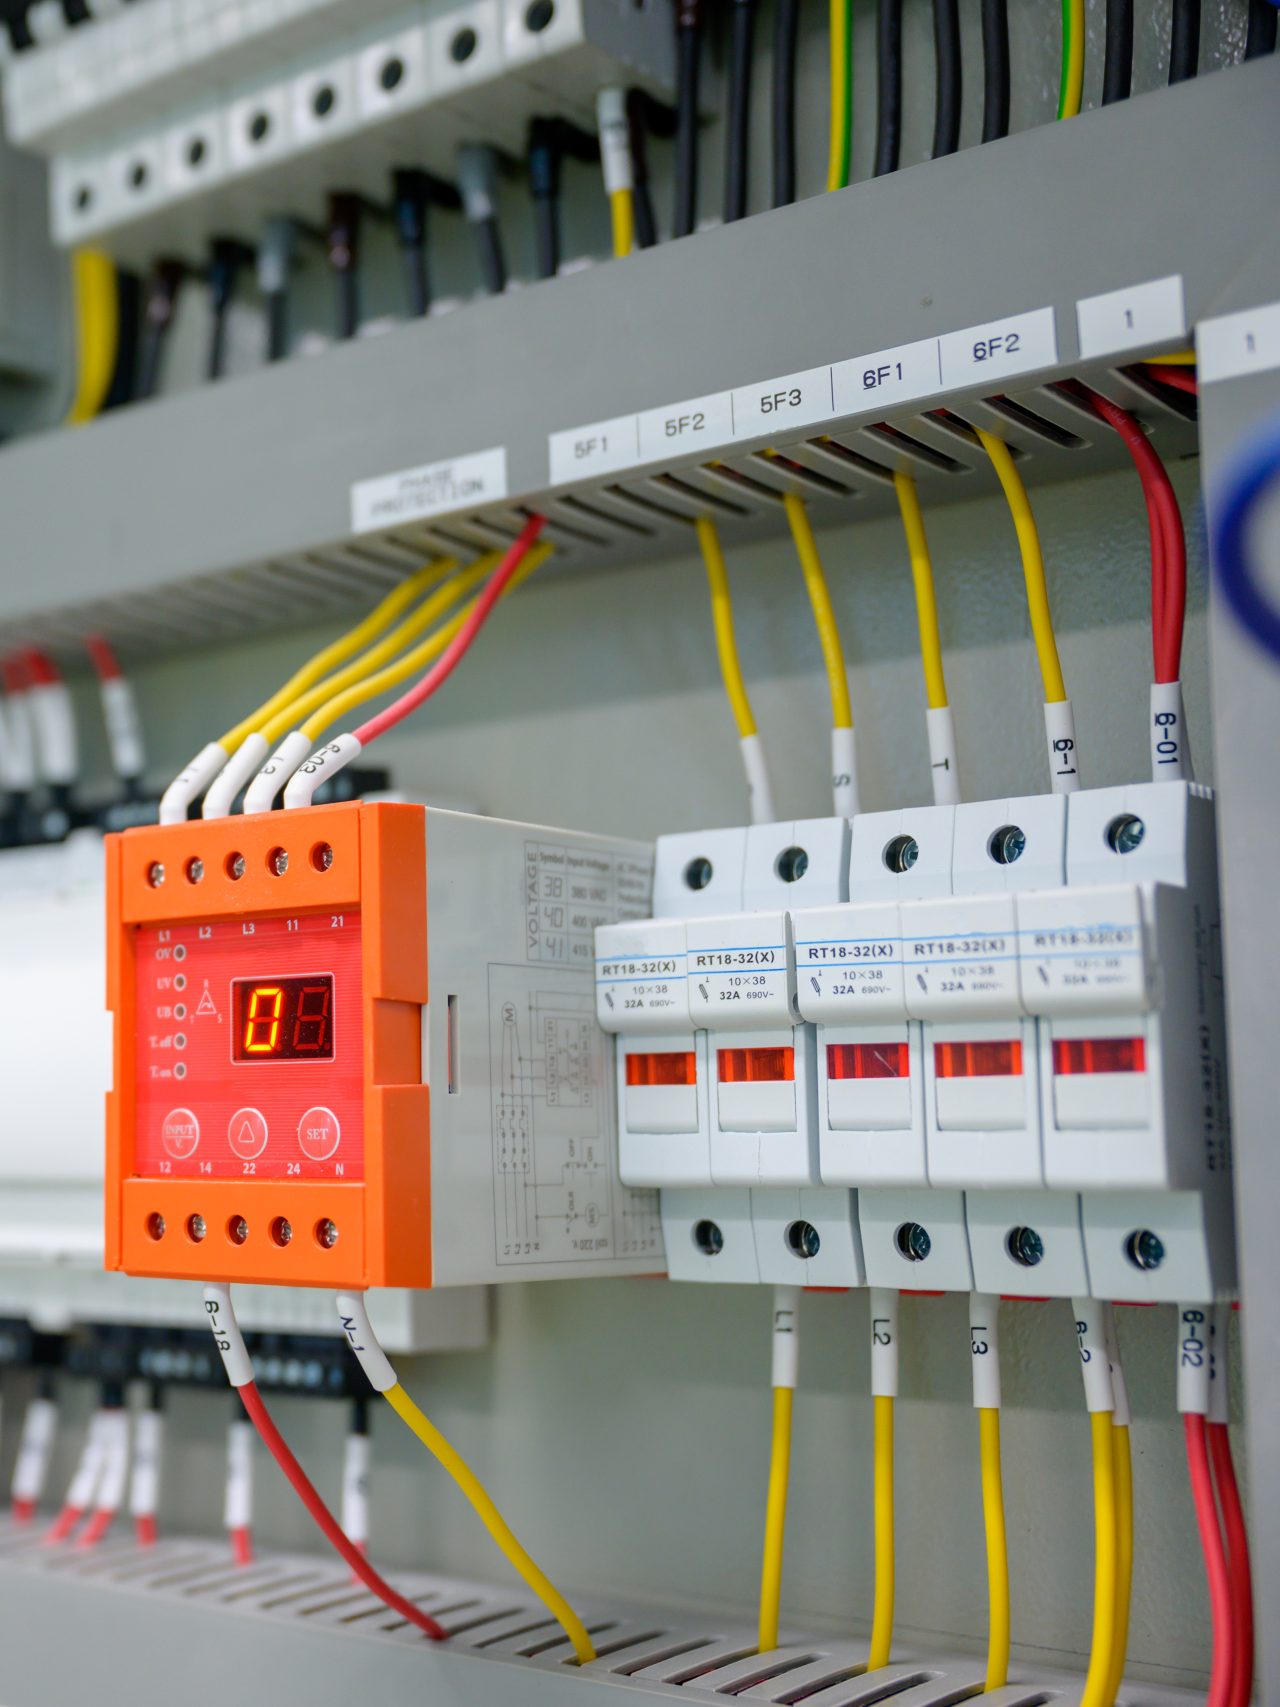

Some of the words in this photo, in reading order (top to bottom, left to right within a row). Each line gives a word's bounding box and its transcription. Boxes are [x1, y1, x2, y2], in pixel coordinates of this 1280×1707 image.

[1124, 309, 1133, 329] 1
[973, 333, 1020, 363] 6F2
[1245, 333, 1255, 354] 1
[863, 363, 902, 390] 6F1
[761, 389, 802, 413] 5F3
[665, 413, 705, 437] 5F2
[574, 437, 607, 459] 5F1
[370, 478, 483, 515] PROTECTION
[1155, 712, 1178, 764] 6-01
[1053, 738, 1076, 775] 6-1
[932, 758, 949, 771] T
[832, 774, 851, 788] S
[527, 852, 538, 948] VOLTAGE
[287, 919, 298, 931] 11
[330, 915, 343, 928] 21
[159, 930, 170, 942] L1
[199, 927, 211, 938] L2
[242, 923, 255, 935] L3
[809, 944, 894, 959] RT18-32(X)
[914, 939, 1006, 955] RT18-32(X)
[697, 950, 775, 966] RT18-32(X)
[603, 960, 676, 975] RT18-32(X)
[832, 985, 855, 994] 32A
[940, 982, 965, 991] 32A
[720, 991, 740, 1001] 32A
[624, 1000, 644, 1009] 32A
[505, 1008, 514, 1021] M
[166, 1124, 195, 1136] INPUT
[306, 1127, 329, 1140] SET
[160, 1161, 171, 1173] 12
[200, 1161, 212, 1173] 14
[242, 1162, 255, 1175] 22
[287, 1162, 300, 1174] 24
[335, 1163, 344, 1175] N
[776, 1310, 793, 1333] L1
[872, 1318, 892, 1345] L2
[970, 1326, 989, 1355] L3
